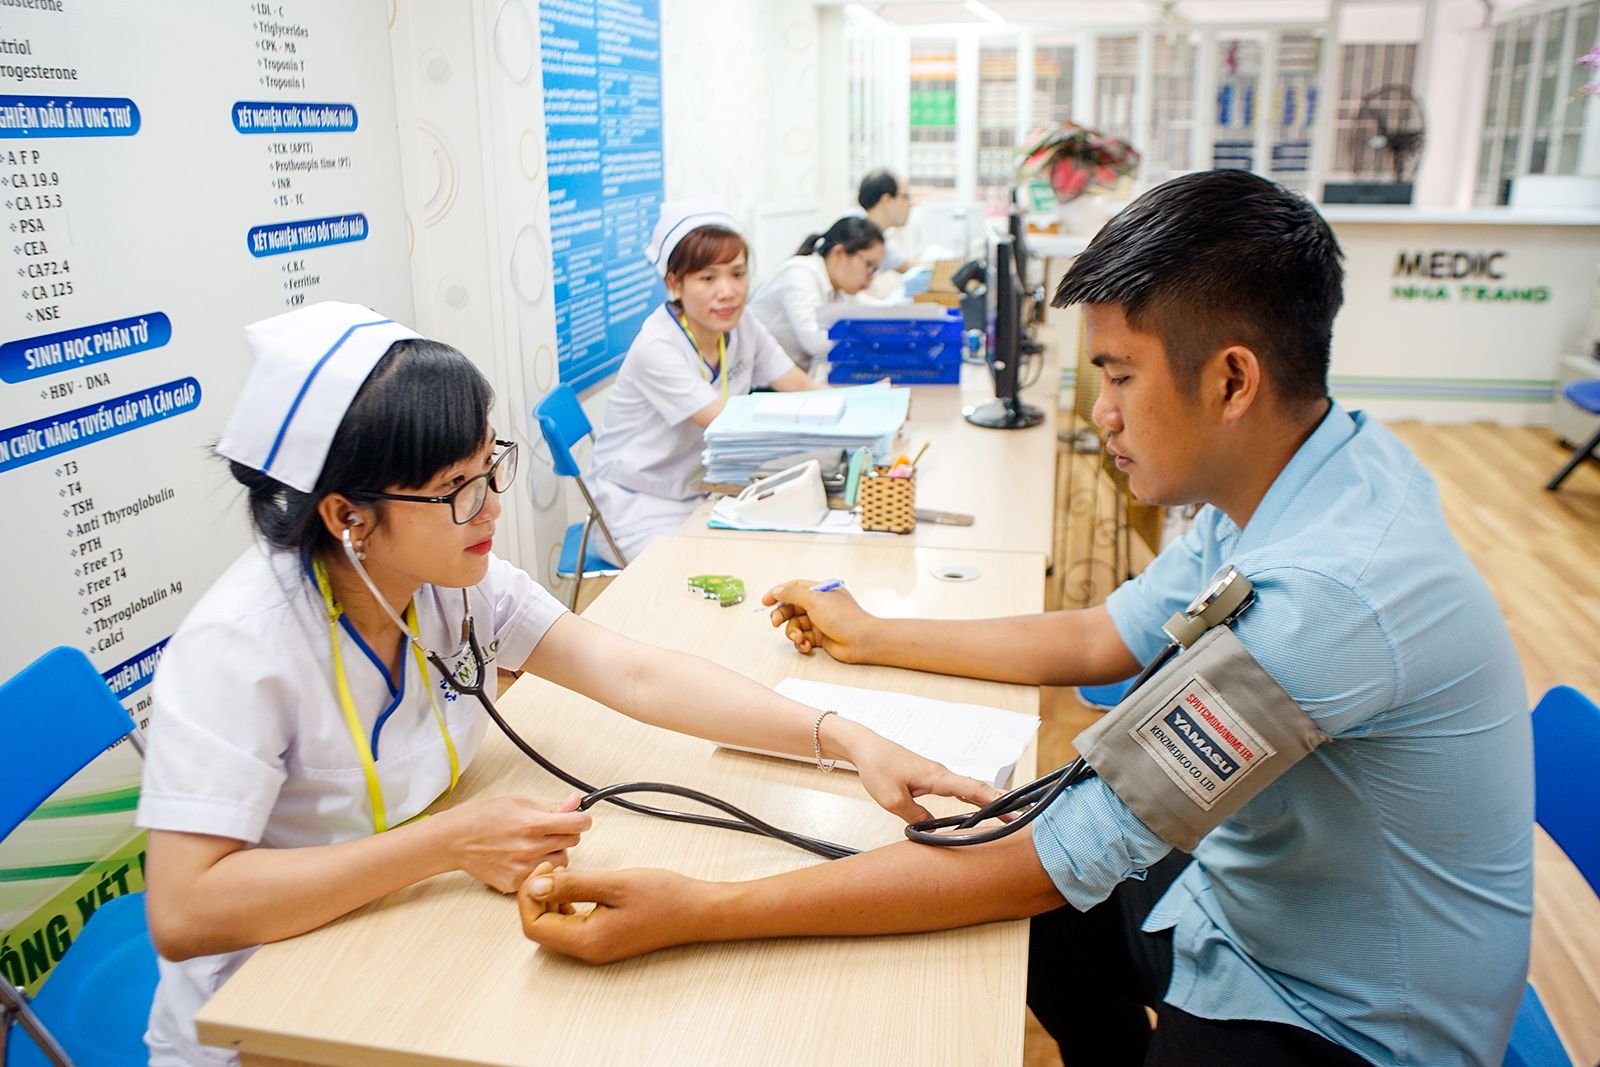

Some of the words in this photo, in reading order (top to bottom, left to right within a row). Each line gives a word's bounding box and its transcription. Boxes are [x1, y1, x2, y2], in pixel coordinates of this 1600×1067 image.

[257, 3, 271, 15] LDL
[259, 21, 308, 38] Triglycerides
[0, 39, 32, 55] triol
[261, 40, 277, 52] CPK
[263, 58, 298, 72] Troponin
[266, 75, 300, 90] Troponin
[83, 107, 109, 128] UNG
[108, 105, 131, 128] THƯ
[8, 151, 17, 165] A
[20, 150, 27, 165] F
[32, 150, 40, 164] P
[12, 174, 29, 188] CA
[32, 172, 59, 187] 19.9
[277, 178, 291, 189] INR
[16, 196, 33, 211] CA
[36, 194, 63, 210] 15.3
[19, 218, 45, 234] PSA
[298, 225, 316, 245] THEO
[24, 241, 48, 256] CEA
[28, 260, 70, 278] CA72.4
[1394, 250, 1508, 279] MEDIC
[32, 286, 48, 301] CA
[51, 281, 74, 297] 125
[288, 274, 320, 290] Ferritine
[291, 293, 305, 306] CRP
[36, 306, 61, 322] NSE
[24, 343, 62, 370] SINH
[63, 336, 92, 364] HỌC
[94, 326, 131, 354] PHÂN
[49, 381, 75, 399] HBV
[86, 372, 111, 389] DNA
[10, 428, 45, 458] CHỨC
[44, 421, 79, 448] NĂNG
[77, 405, 114, 437] TUYẾN
[114, 399, 138, 426] GIÁP
[138, 394, 154, 419] VÀ
[154, 389, 173, 417] CẬN
[174, 382, 195, 408] GIÁP
[64, 461, 78, 476] T3
[67, 481, 83, 496] T4
[71, 498, 94, 516] TSH
[76, 515, 100, 536] Anti
[102, 487, 175, 525] Thyroglobulin
[79, 536, 102, 556] PTH
[83, 557, 107, 575] Free
[110, 548, 124, 563] T3
[87, 576, 111, 595] Free
[113, 567, 127, 582] T4
[90, 594, 113, 614] TSH
[93, 587, 168, 633] Thyroglobulin
[170, 580, 183, 595] Ag
[98, 628, 125, 652] Calci
[1150, 725, 1192, 769] KENZMEDICO
[1173, 712, 1233, 774] YAMASU
